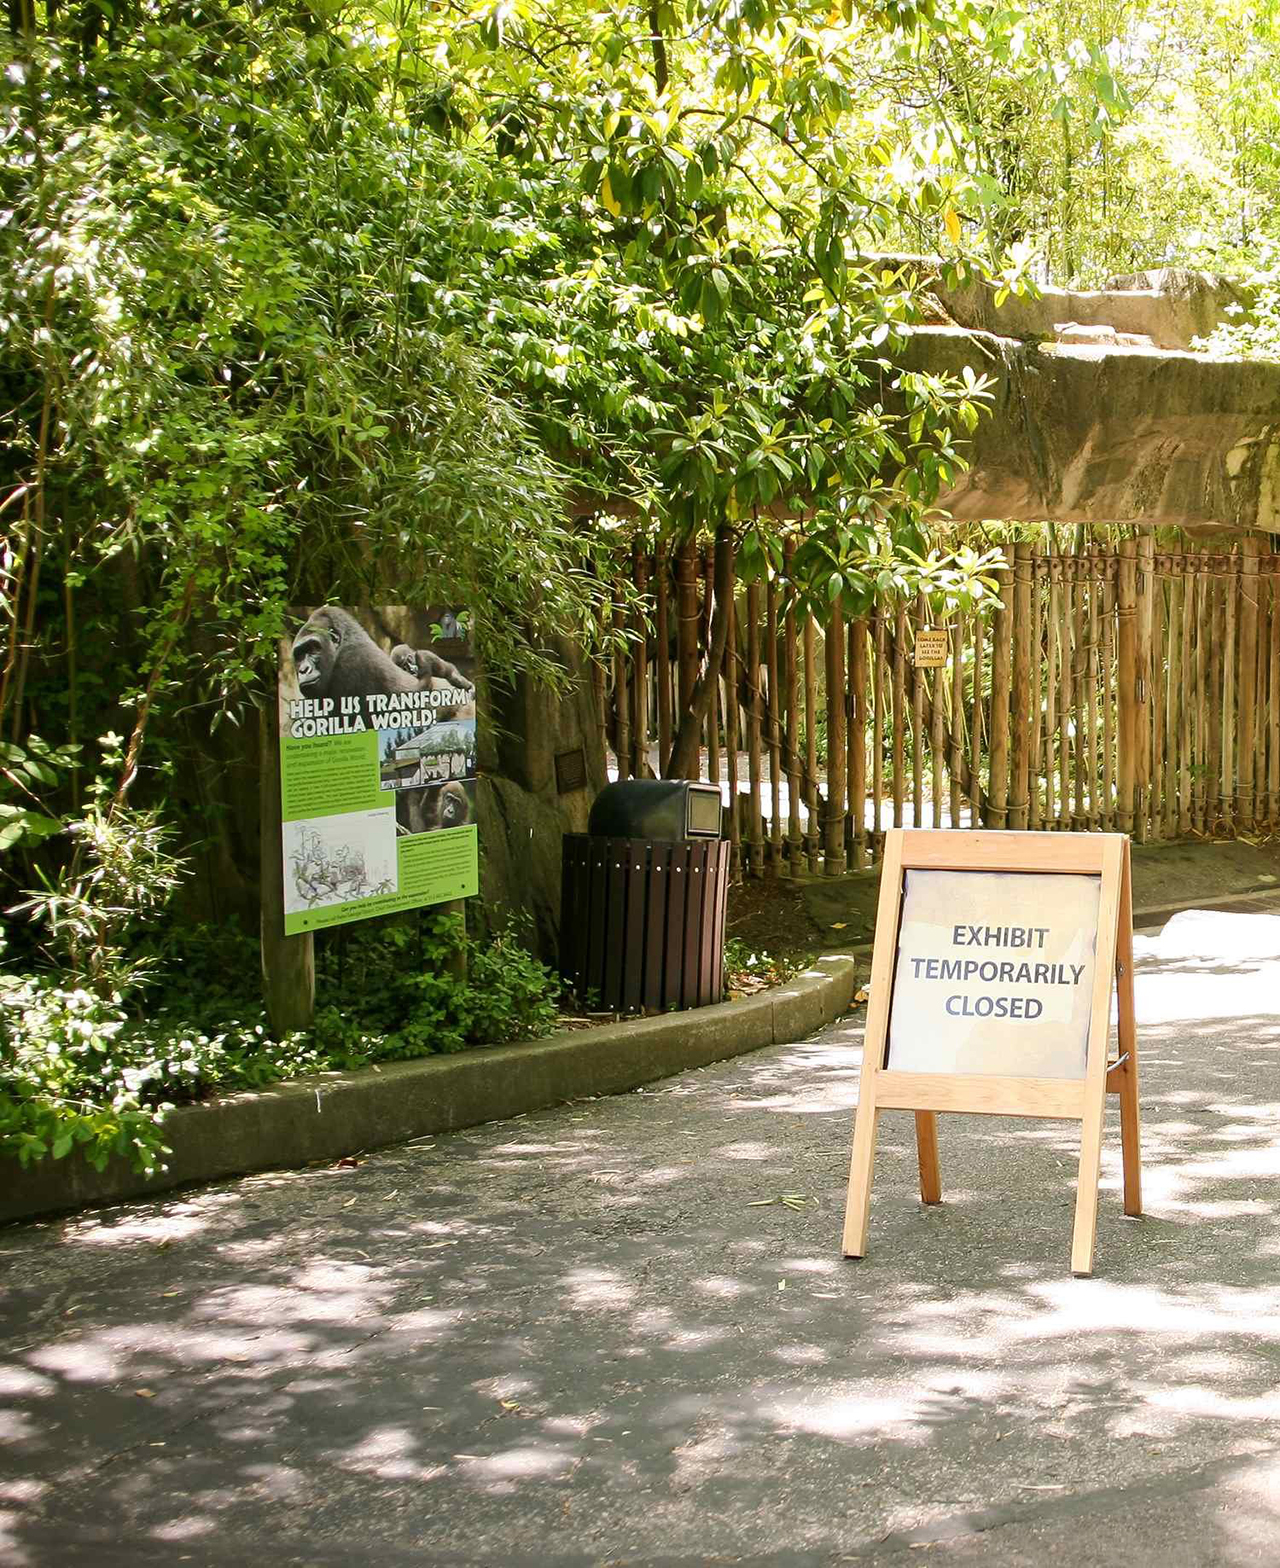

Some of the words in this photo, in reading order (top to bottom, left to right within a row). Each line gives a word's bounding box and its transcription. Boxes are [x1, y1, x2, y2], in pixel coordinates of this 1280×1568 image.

[291, 698, 334, 718] HELP
[340, 696, 361, 714] US
[366, 690, 467, 711] TRANSFORM
[291, 716, 366, 737] GORILLA
[371, 710, 437, 730] WORLD!
[952, 925, 1050, 948] EXHIBIT
[910, 958, 1086, 985] TEMPORARILY
[945, 995, 1043, 1019] CLOSED
